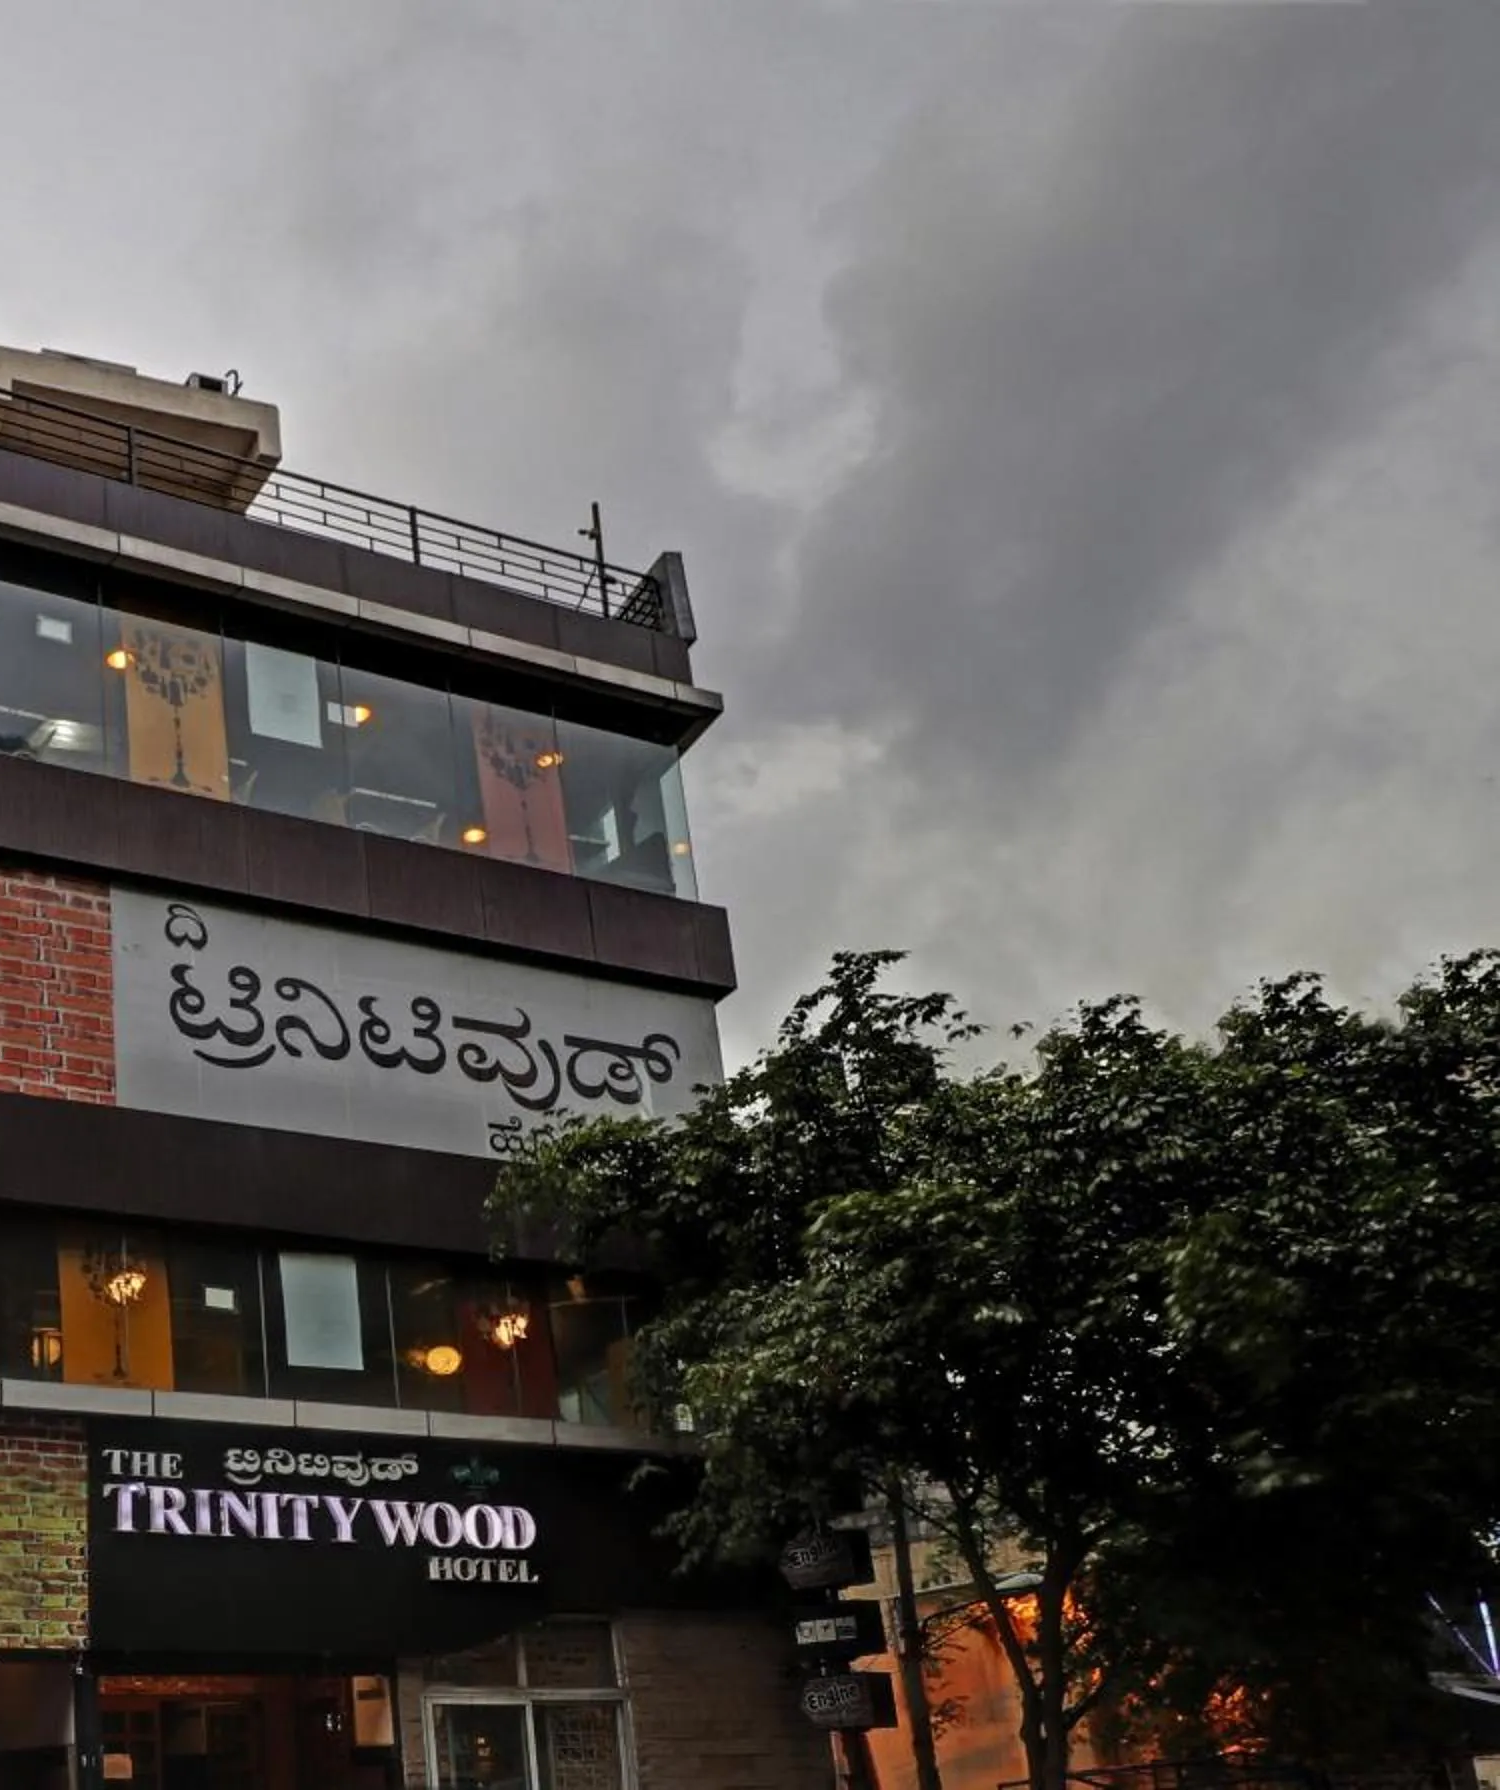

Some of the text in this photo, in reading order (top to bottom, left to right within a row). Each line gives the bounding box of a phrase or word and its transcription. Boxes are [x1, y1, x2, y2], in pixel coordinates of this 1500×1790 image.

[165, 903, 208, 950] ದಿ
[102, 1448, 183, 1480] THE
[428, 1556, 539, 1584] HOTEL
